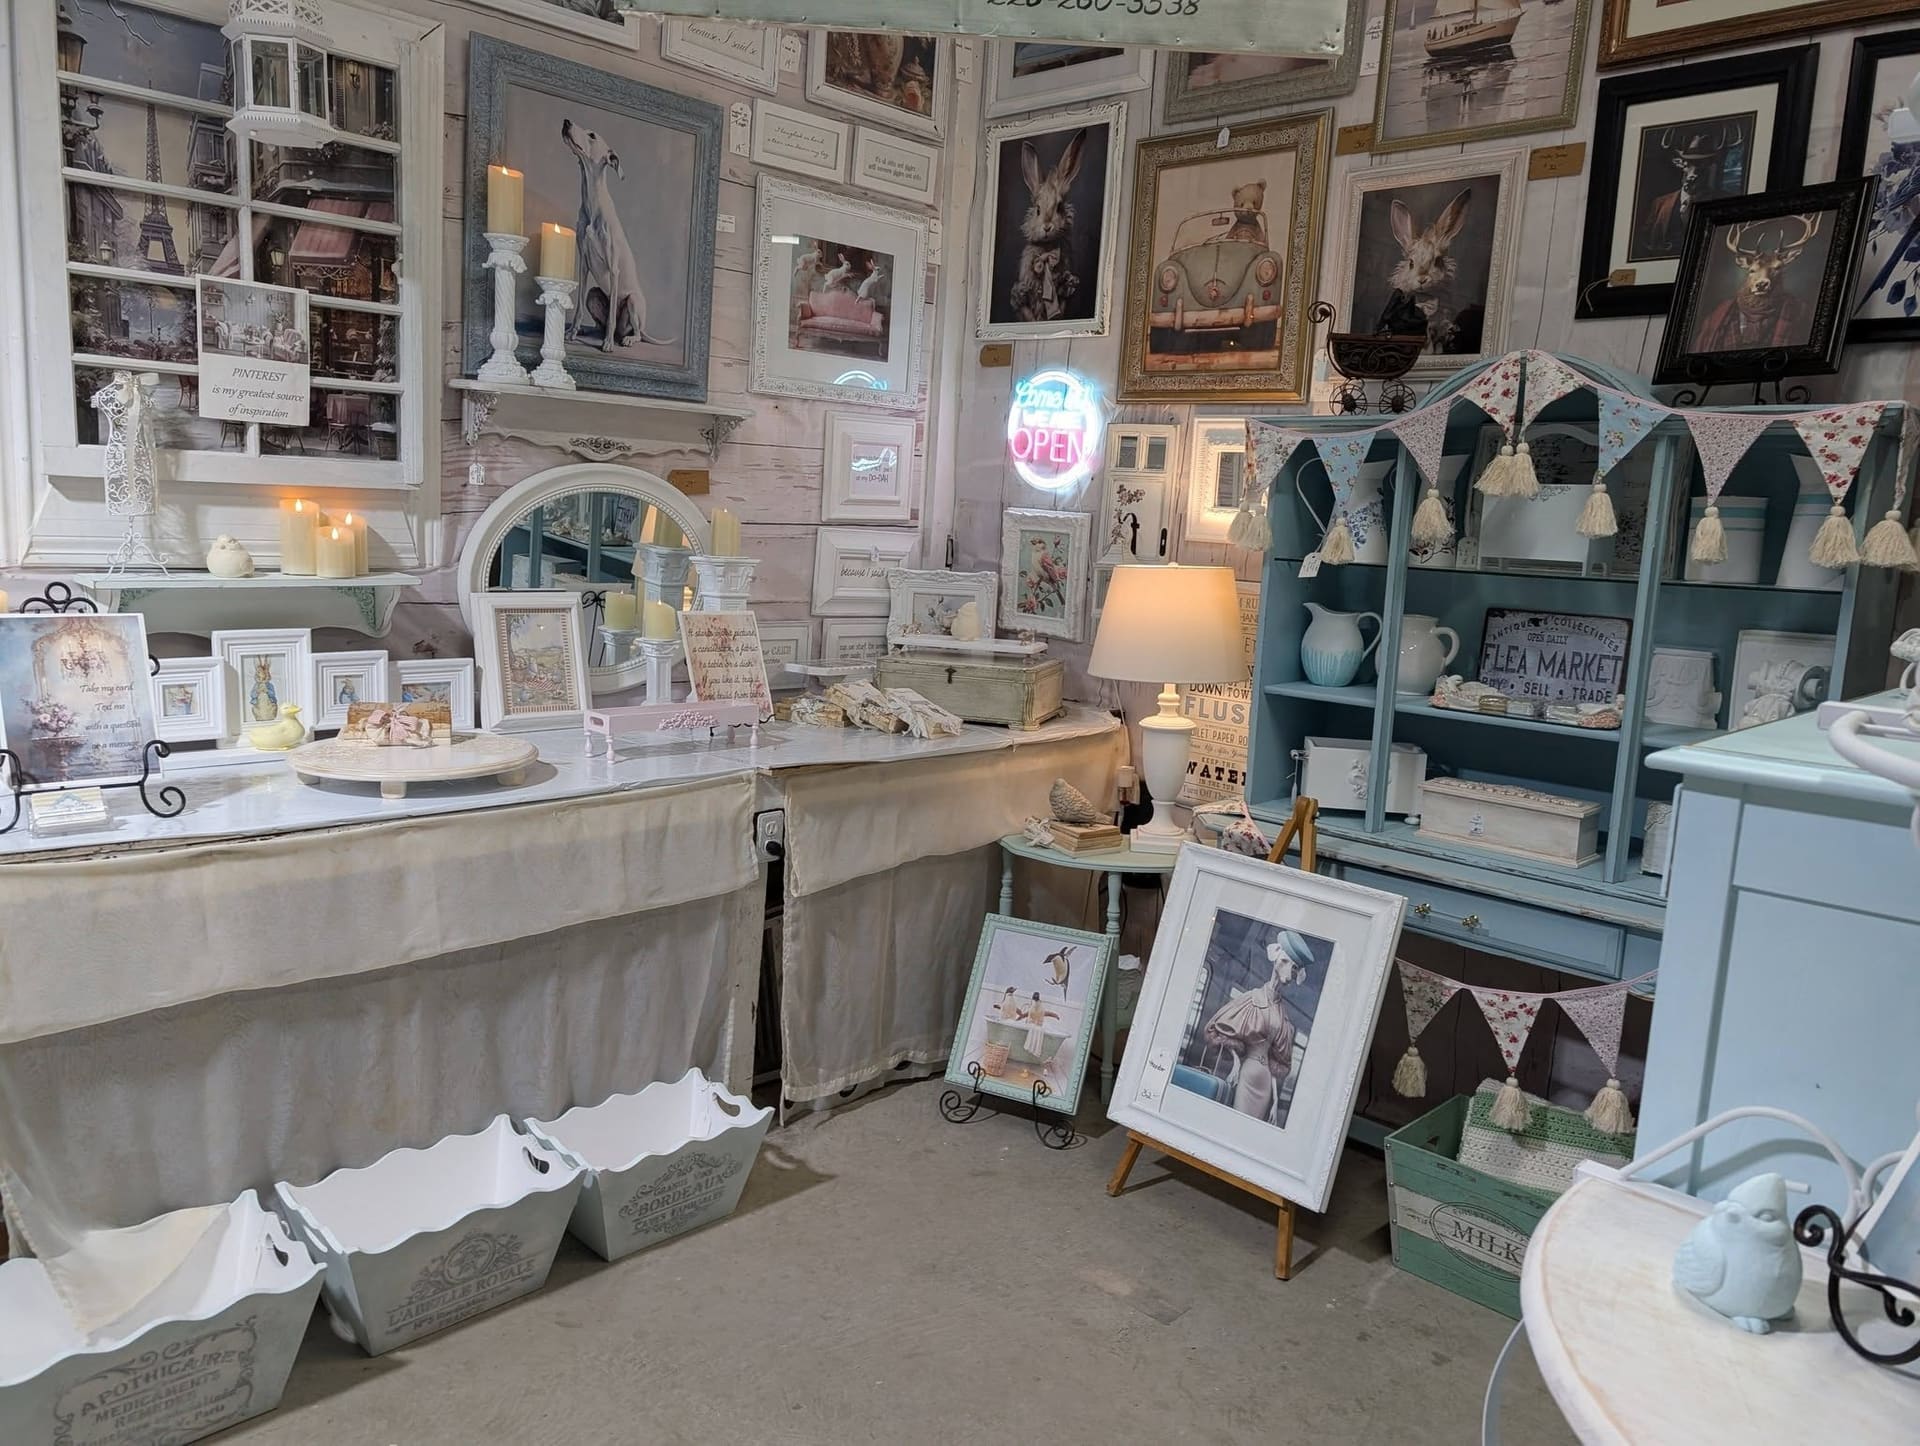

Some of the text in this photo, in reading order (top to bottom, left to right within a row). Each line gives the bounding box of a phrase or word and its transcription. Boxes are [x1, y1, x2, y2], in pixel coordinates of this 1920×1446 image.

[232, 367, 288, 382] PINTEREST
[212, 384, 305, 403] is my greatest source
[228, 402, 289, 418] of inspiration
[1011, 426, 1089, 464] OPEN
[1491, 619, 1543, 642] ANTIQUE
[1552, 615, 1621, 653] COLLECTIBLES
[1527, 632, 1545, 643] OPEN
[1481, 643, 1624, 685] FLEA MARKET
[80, 681, 135, 696] Take my card
[1227, 687, 1250, 700] TOW
[1523, 681, 1550, 697] SELL
[1571, 687, 1613, 704] TRADE
[1183, 695, 1246, 725] FLUS
[1191, 727, 1210, 740] OILET
[1212, 729, 1235, 744] PAPER
[637, 1175, 725, 1216] BORDEAUX
[1451, 1220, 1522, 1265] MILK
[475, 1258, 536, 1293] ROYALE
[80, 1350, 237, 1417] APOTHICAIRE
[95, 1367, 221, 1425] MEDICAMENTS
